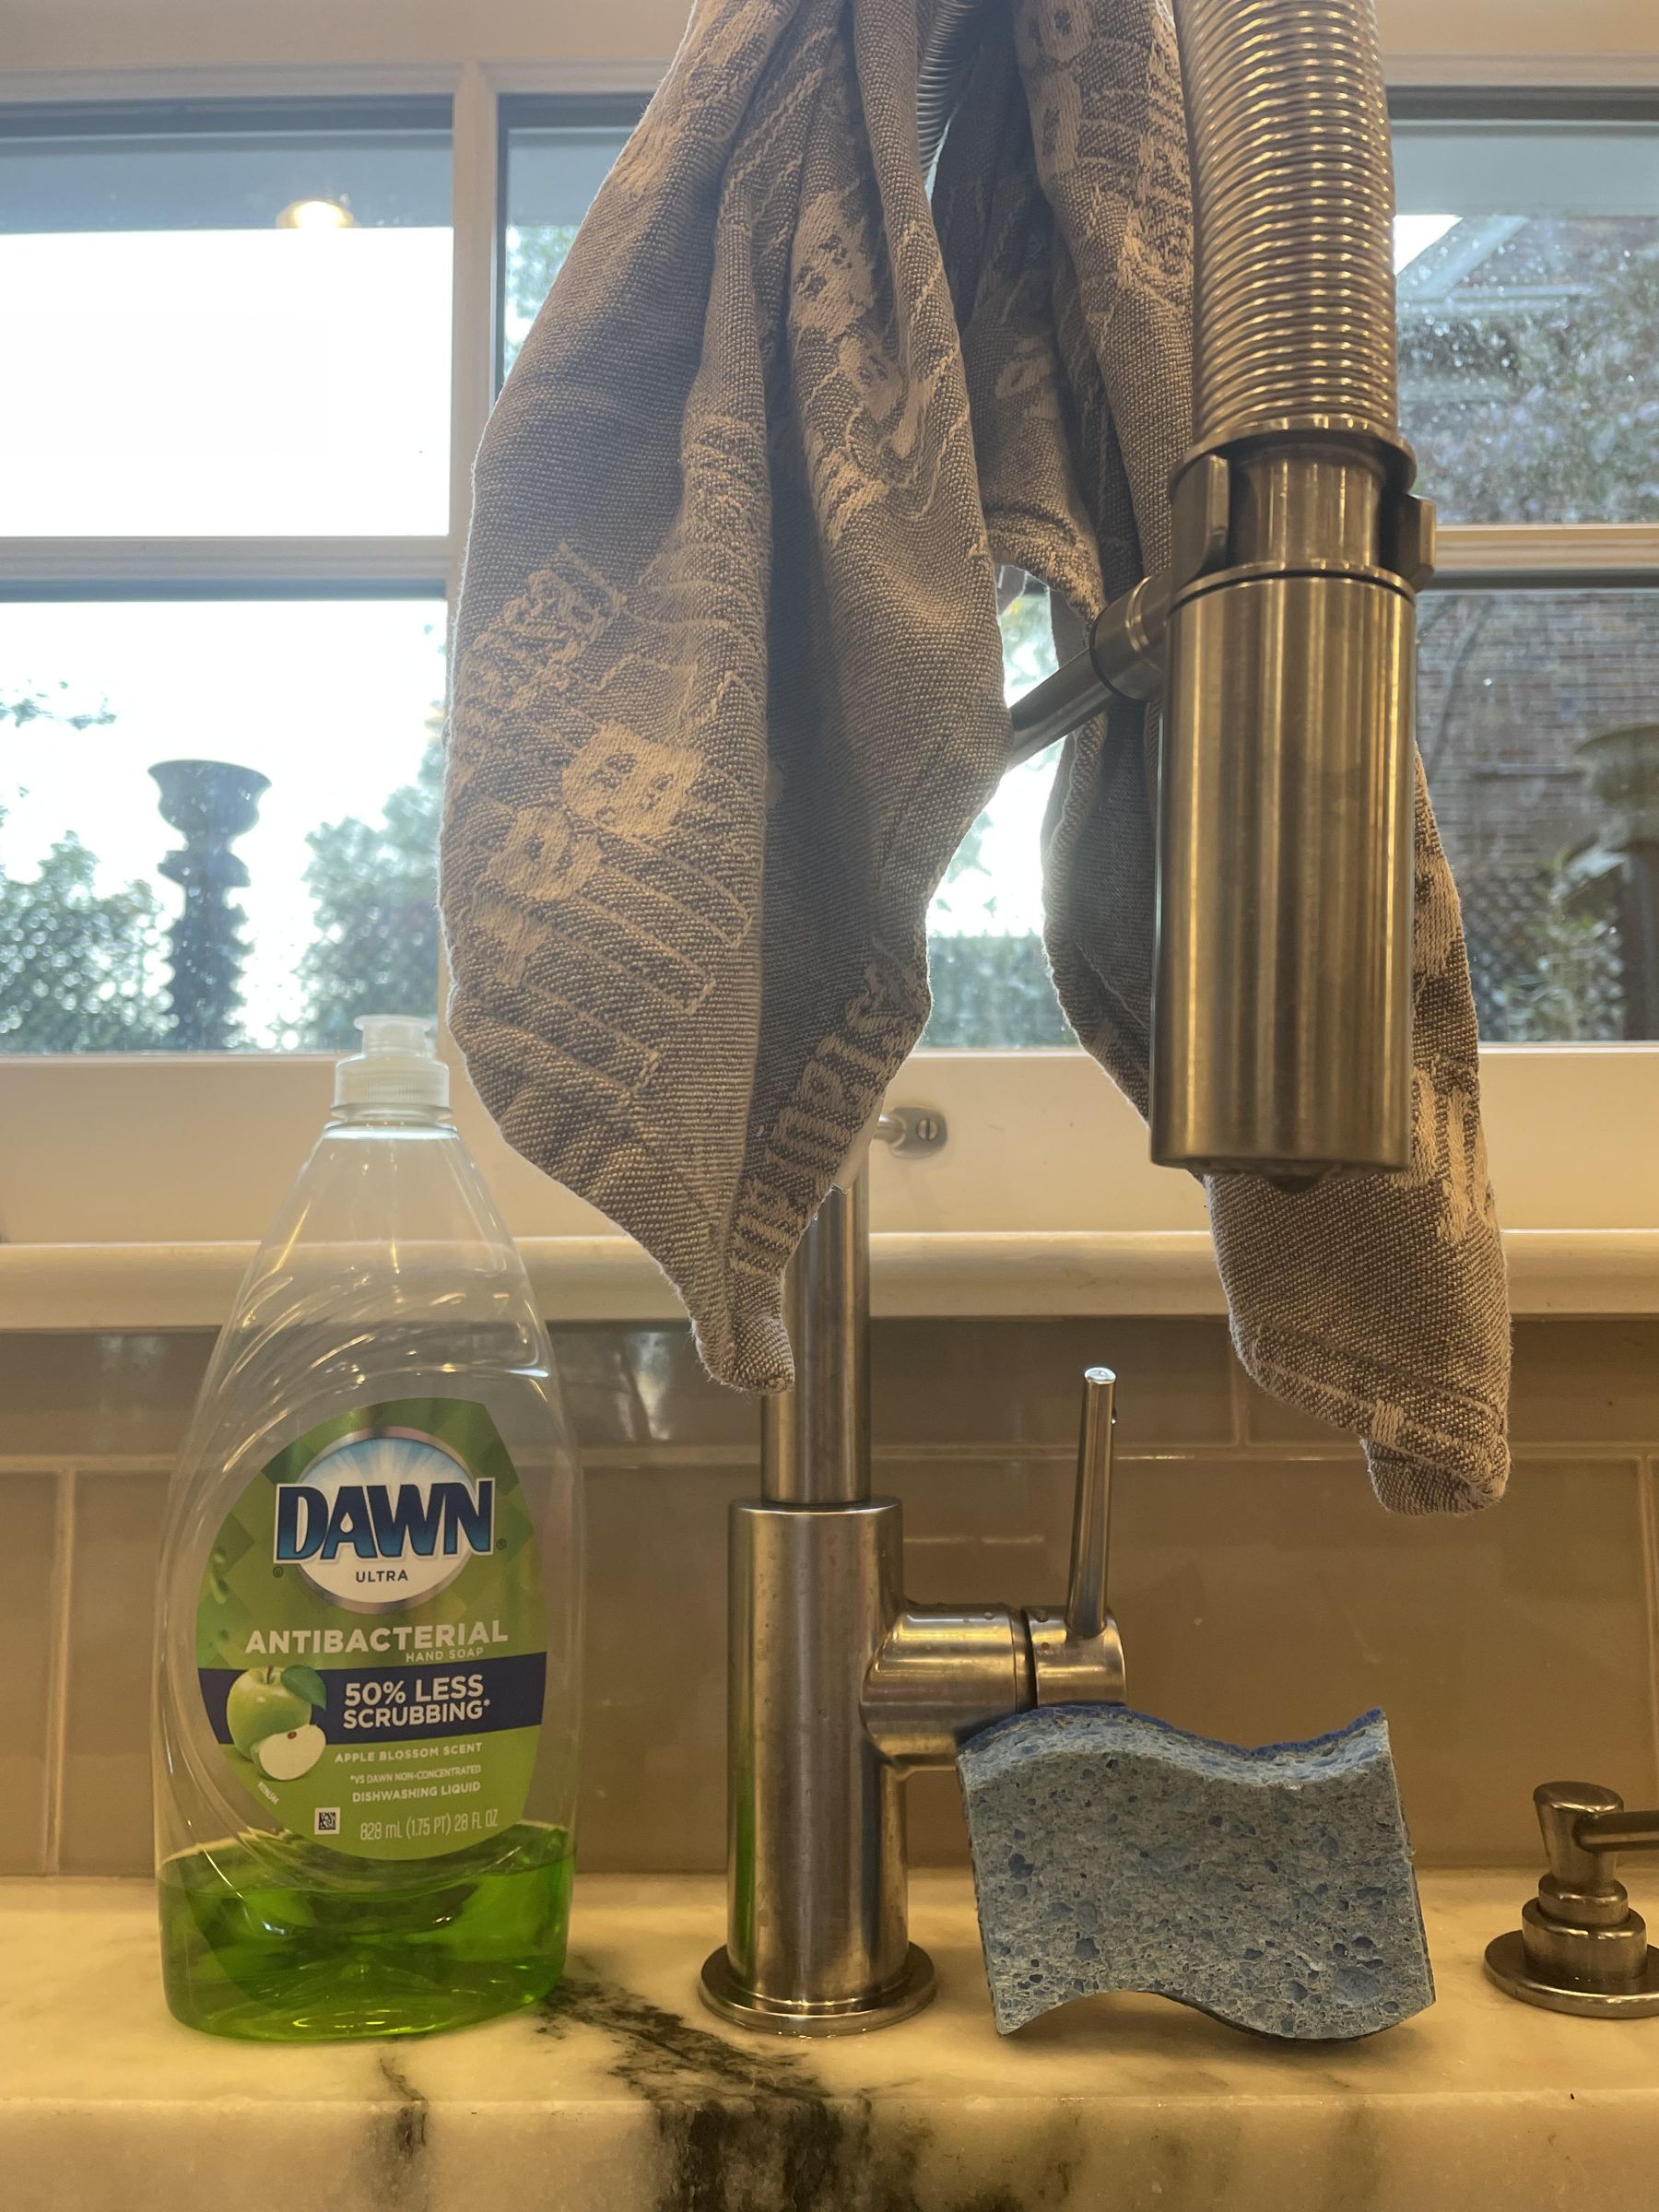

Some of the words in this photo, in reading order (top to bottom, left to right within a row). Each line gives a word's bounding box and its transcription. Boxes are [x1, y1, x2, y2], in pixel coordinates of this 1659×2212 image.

[275, 1477, 495, 1563] DAWN
[355, 1570, 409, 1583] ULTRA
[244, 1620, 509, 1654] ANTIBACTERIAL
[406, 1651, 444, 1663] HAND
[449, 1647, 484, 1659] SOAP
[344, 1680, 406, 1706] 50%
[415, 1674, 485, 1703] LESS
[335, 1752, 375, 1764] APPLE
[379, 1747, 440, 1761] BLOSSOM
[442, 1742, 483, 1756] SCENT
[367, 1772, 394, 1784] DAWN
[394, 1764, 481, 1782] NON-CONCENTRATED
[352, 1786, 438, 1804] DISHWASHING
[441, 1782, 481, 1796] LIQUID
[360, 1821, 382, 1841] 828
[406, 1816, 430, 1840] (1.75
[433, 1813, 451, 1837] PT)
[454, 1812, 469, 1832] 28
[471, 1811, 483, 1830] FL
[485, 1808, 499, 1828] OZ
